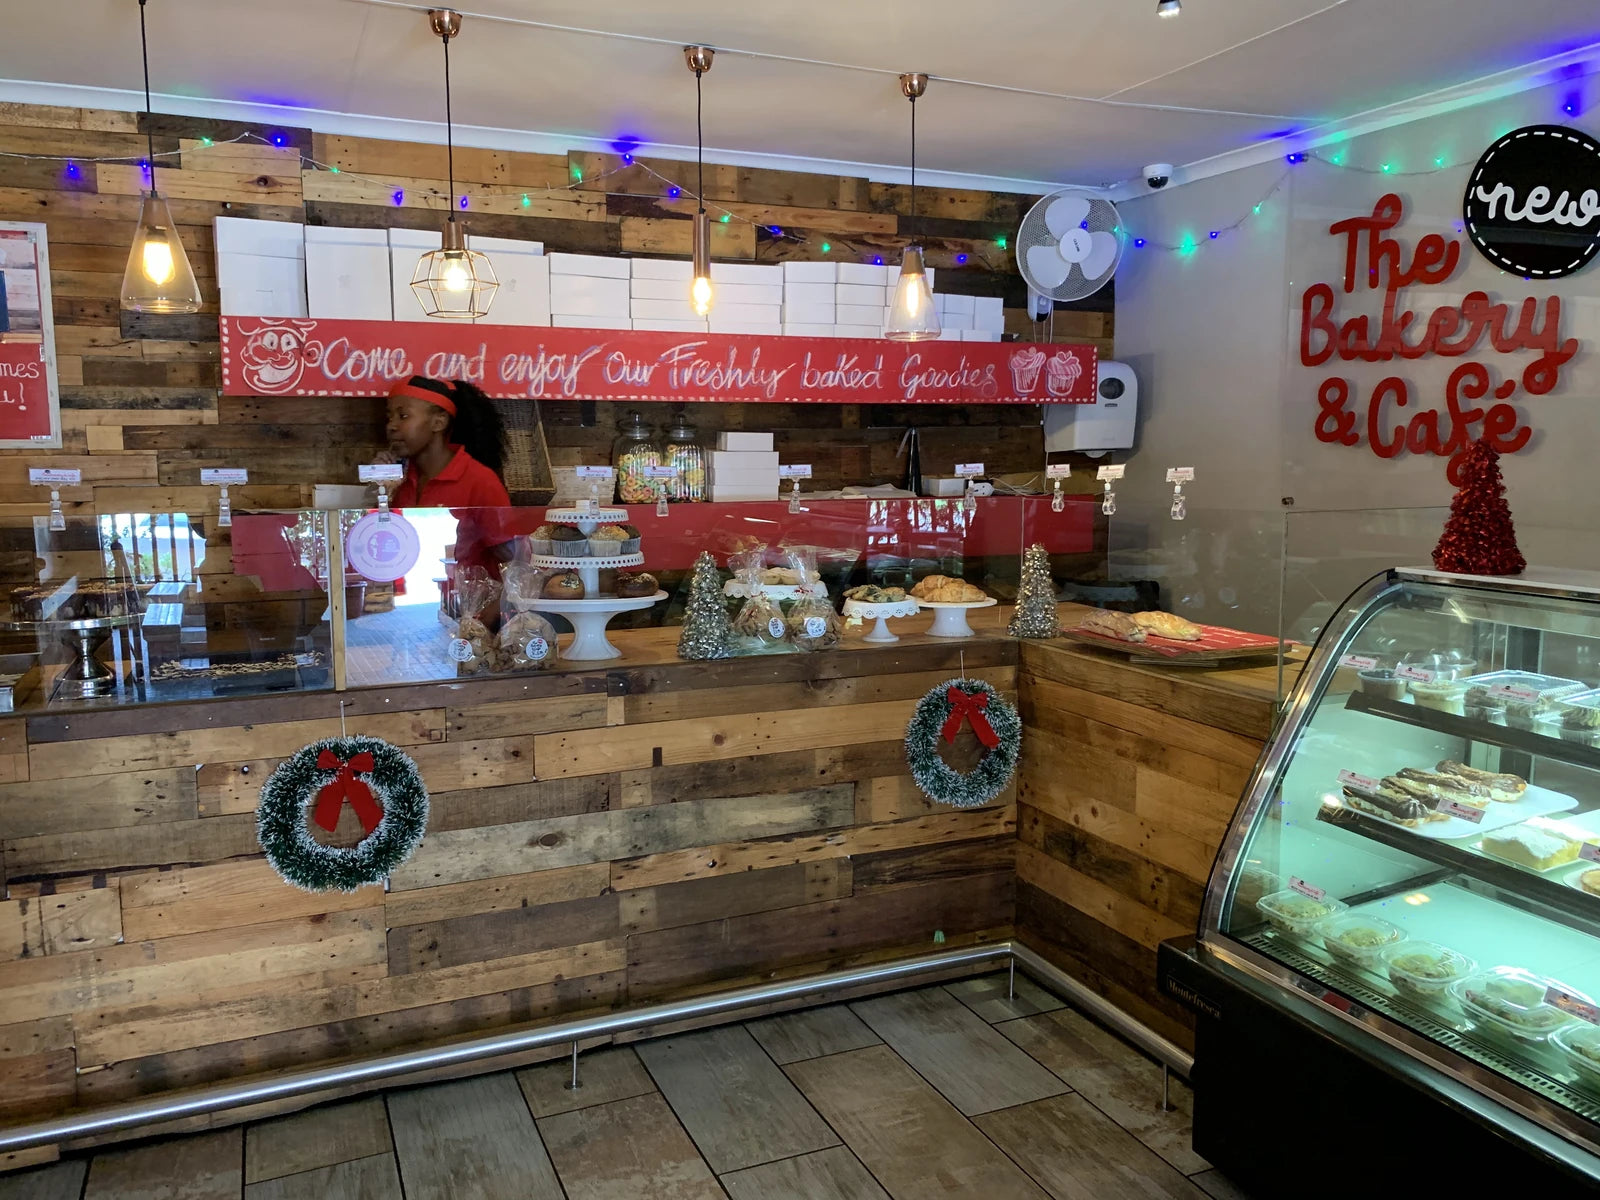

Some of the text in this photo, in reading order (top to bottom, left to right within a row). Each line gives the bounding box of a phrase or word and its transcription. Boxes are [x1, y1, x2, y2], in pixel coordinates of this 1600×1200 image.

[1476, 182, 1600, 227] new
[1330, 193, 1460, 293] The
[320, 337, 413, 381] Come
[423, 343, 487, 381] and
[502, 344, 608, 397] enjoy
[603, 351, 660, 385] Our
[660, 341, 796, 398] Freshly
[900, 355, 1000, 399] Goodies
[1300, 283, 1578, 395] Bakery
[1315, 377, 1359, 446] &
